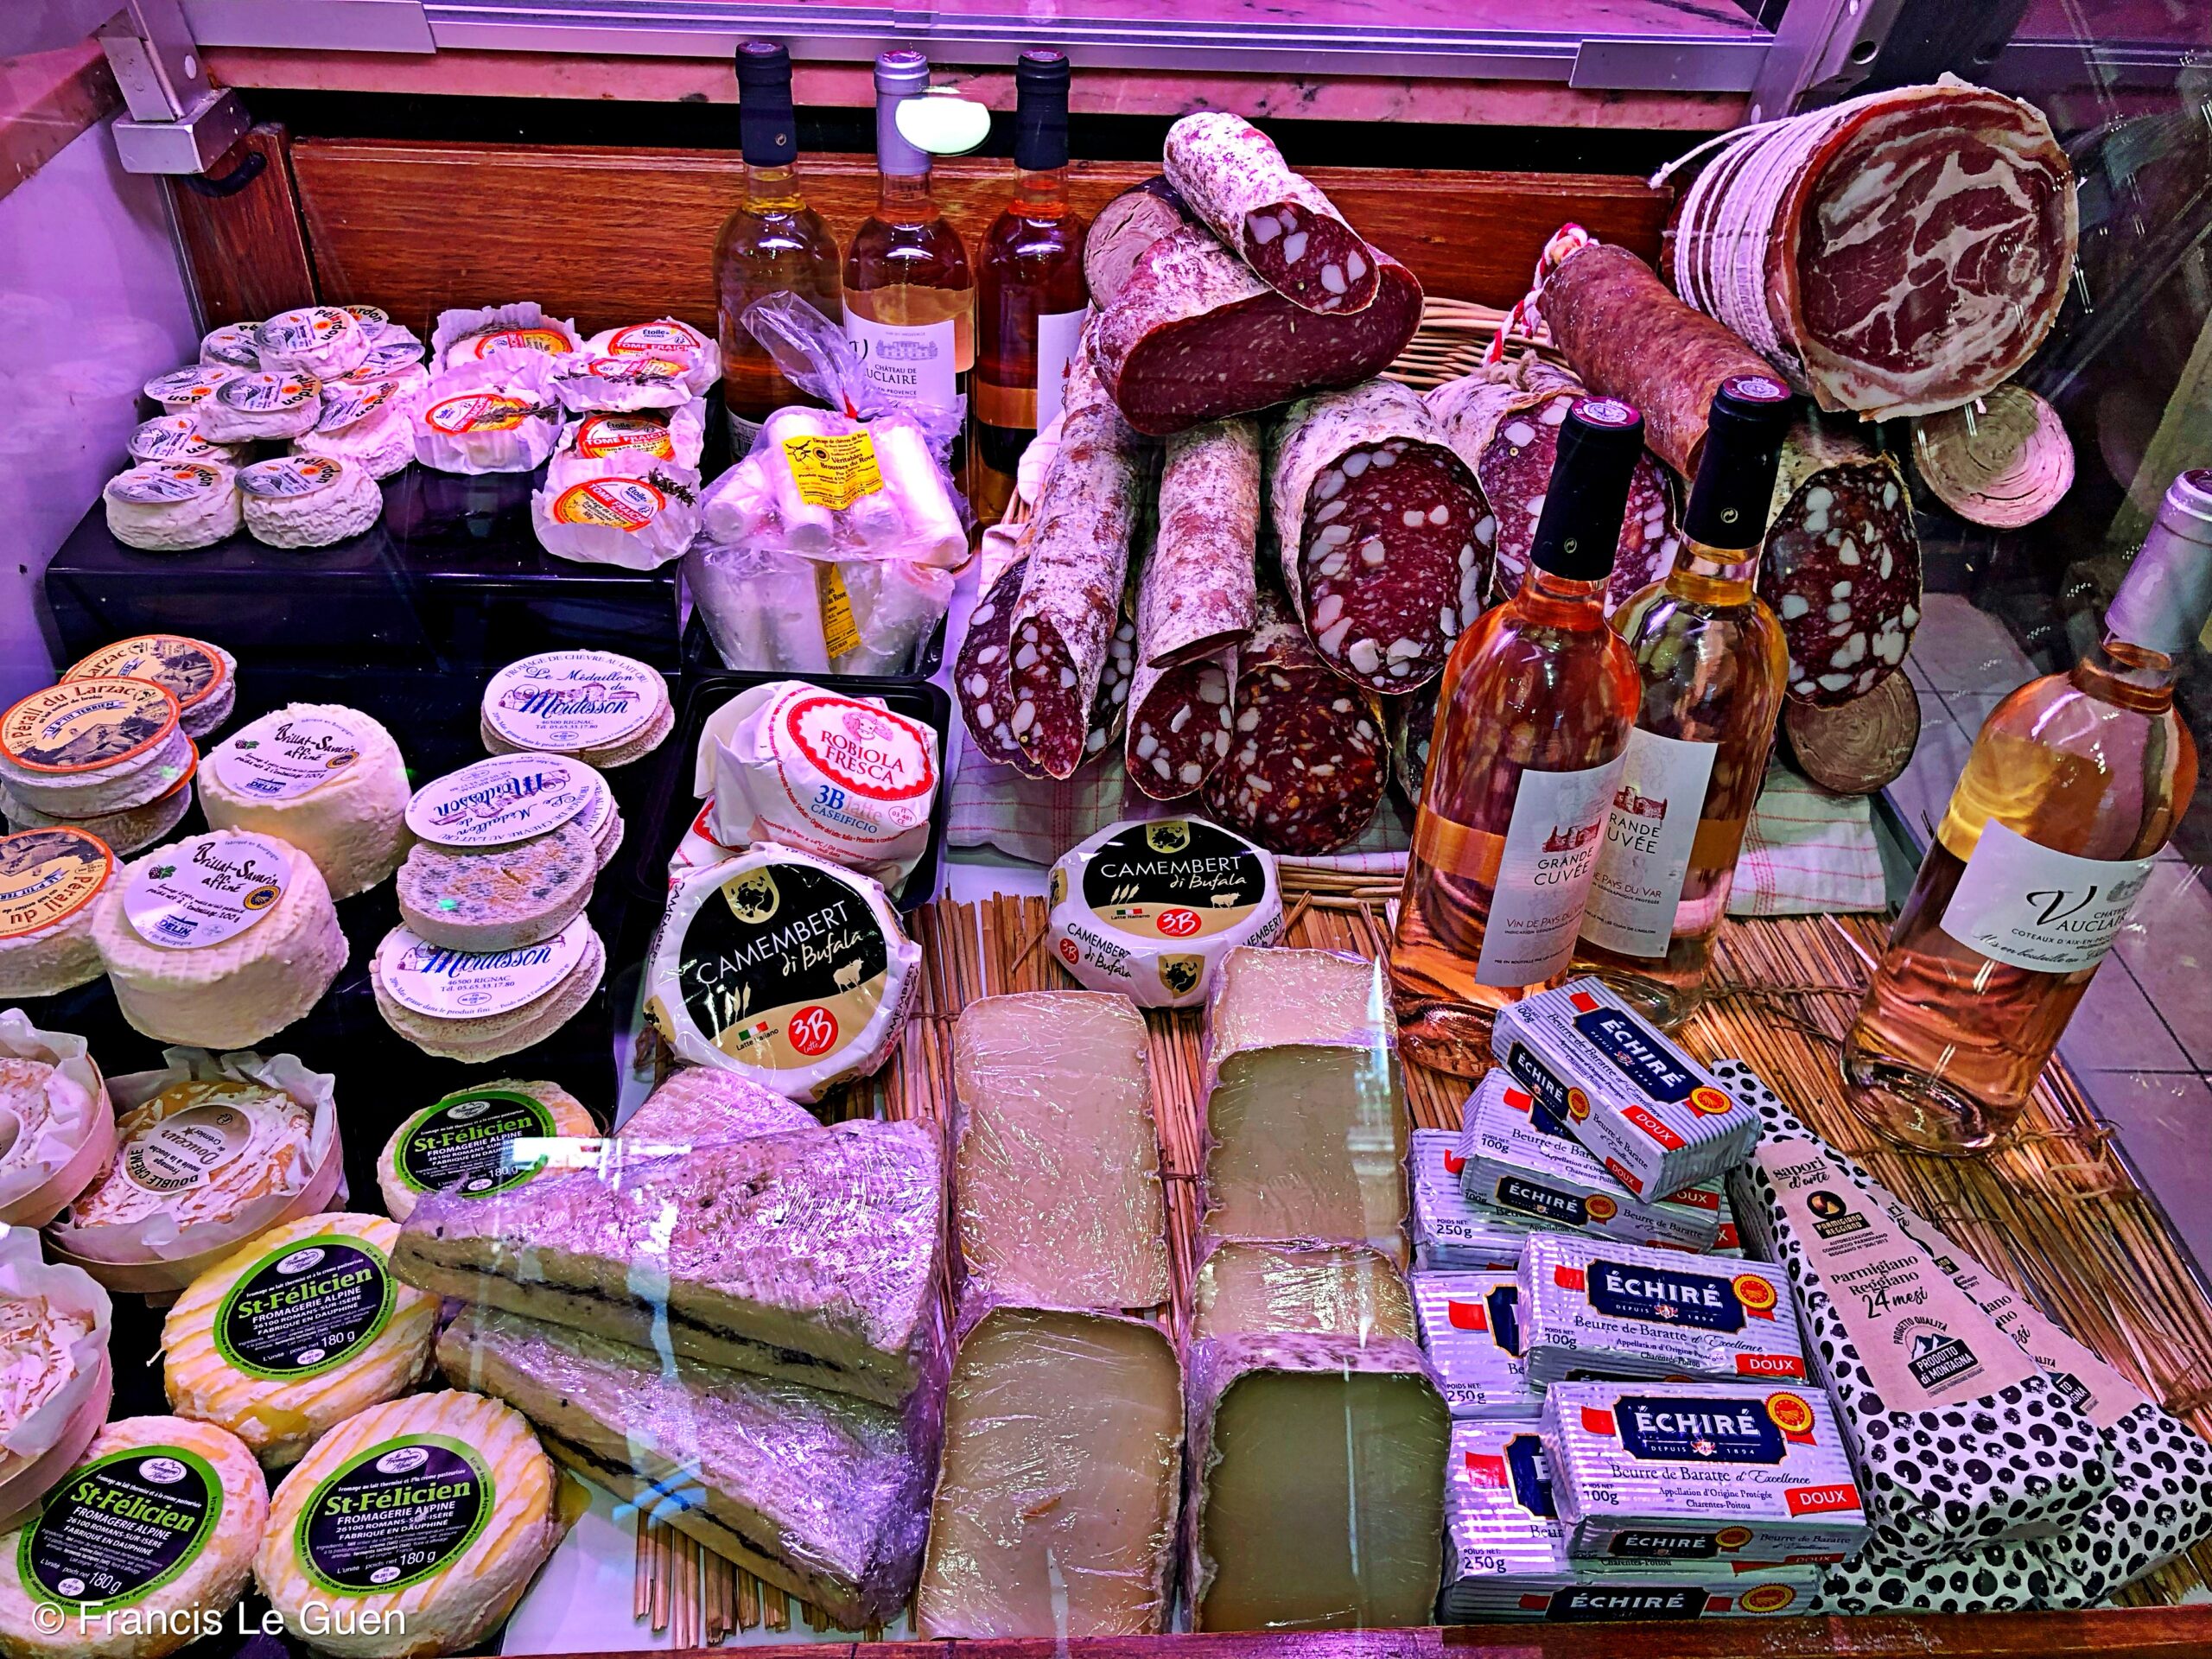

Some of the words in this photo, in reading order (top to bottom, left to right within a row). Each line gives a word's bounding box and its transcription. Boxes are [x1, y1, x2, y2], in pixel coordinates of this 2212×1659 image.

[864, 368, 917, 385] UCLAIRE
[875, 364, 906, 374] CHÂTEAU
[832, 453, 862, 463] Véritables
[858, 454, 875, 464] Rove
[588, 484, 613, 502] TOME
[627, 486, 646, 502] Étoile
[524, 667, 552, 679] Le
[556, 670, 633, 681] Médaillon
[44, 693, 67, 707] du
[74, 686, 136, 696] Larzac
[275, 723, 356, 753] Brillat-Savarin
[284, 747, 326, 761] affiné
[821, 730, 905, 773] ROBIOLA
[825, 747, 895, 785] FRESCA
[251, 781, 282, 792] DELIN
[814, 785, 845, 810] 3B
[810, 803, 878, 835] CASEIFICIO
[1609, 813, 1661, 838] RANDE
[1607, 828, 1656, 855] UVÉE
[194, 842, 278, 886] Brillat-Savarin
[1101, 856, 1241, 878] CAMEMBERT
[1537, 846, 1594, 869] GRANDE
[201, 874, 246, 893] affiné
[1189, 873, 1247, 890] Bufala
[1534, 861, 1590, 887] CUVÉE
[1601, 874, 1623, 890] PAYS
[1624, 884, 1640, 894] DU
[1643, 888, 1662, 899] VAR
[10, 910, 38, 924] du
[159, 919, 192, 937] DELIN
[1162, 911, 1196, 935] 3B
[1506, 918, 1523, 928] VIN
[1526, 918, 1538, 928] DE
[1540, 915, 1559, 928] PAYS
[1561, 912, 1573, 923] DU
[696, 900, 849, 984] CAMEMBERT
[1067, 922, 1132, 959] CAMEMBERT
[2011, 927, 2056, 944] COTEAUX
[802, 928, 863, 971] Bufala
[474, 975, 512, 984] RIGNAC
[791, 1007, 832, 1048] 3B
[1599, 1019, 1687, 1088] ÉCHIRÉ
[1517, 1052, 1563, 1103] ÉCHIRÉ
[414, 1116, 533, 1153] St-Félicien
[1635, 1113, 1675, 1141] DOUX
[160, 1129, 219, 1165] Douceur
[427, 1138, 488, 1156] FROMAGERIE
[490, 1130, 524, 1142] ALPINE
[1481, 1137, 1510, 1154] 100g
[1593, 1113, 1616, 1139] Beurre
[1624, 1141, 1649, 1169] Baratte
[129, 1149, 151, 1179] CRÈME
[153, 1158, 181, 1175] Fromage
[1611, 1165, 1635, 1185] DOUX
[1773, 1156, 1827, 1180] sapori
[146, 1174, 198, 1188] DOUBLE
[1509, 1183, 1578, 1213] ÉCHIRÉ
[1624, 1209, 1655, 1226] Beurre
[1656, 1220, 1667, 1230] de
[1669, 1221, 1703, 1238] Baratte
[1816, 1214, 1863, 1230] PARMIGIANO
[1825, 1222, 1862, 1236] REGGIANO
[1830, 1255, 1918, 1284] Parmigiano
[238, 1268, 373, 1320] St-Félicien
[1606, 1270, 1723, 1308] ÉCHIRÉ
[1848, 1271, 1919, 1296] Reggiano
[252, 1298, 323, 1324] FROMAGERIE
[323, 1286, 361, 1304] ALPINE
[252, 1319, 280, 1331] 26100
[281, 1294, 362, 1324] ROMANS-SUR-ISÈRE
[1862, 1287, 1891, 1319] 24
[1892, 1286, 1928, 1306] mesi
[257, 1319, 301, 1336] FABRIQUÉ
[302, 1315, 315, 1324] EN
[315, 1302, 359, 1321] DAUPHINÉ
[1575, 1315, 1618, 1332] Beurre
[1623, 1323, 1637, 1333] de
[1640, 1324, 1688, 1341] Baratte
[1893, 1317, 1915, 1344] PROGETTO
[1915, 1316, 1948, 1332] QUALITÀ
[321, 1332, 345, 1348] 180
[346, 1331, 355, 1343] g
[1545, 1333, 1577, 1350] 100g
[1750, 1358, 1795, 1370] DOUX
[1916, 1345, 1958, 1371] PRODOTTO
[1920, 1372, 1930, 1384] di
[1929, 1352, 1974, 1379] MONTAGNA
[1634, 1405, 1761, 1437] ÉCHIRÉ
[1611, 1464, 1658, 1479] Beurre
[1662, 1467, 1677, 1480] de
[1681, 1466, 1731, 1482] Baratte
[324, 1481, 471, 1517] St-Félicien
[1659, 1487, 1701, 1497] Appellation
[1703, 1487, 1738, 1499] d'Origine
[1740, 1490, 1772, 1499] Protégée
[1686, 1499, 1751, 1510] Charentes-Poitou
[1799, 1491, 1847, 1505] DOUX
[70, 1482, 195, 1534] St-Félicien
[337, 1507, 412, 1525] FROMAGERIE
[67, 1516, 90, 1529] 26100
[89, 1522, 163, 1549] ROMANS-SUR-ISÈRE
[73, 1506, 136, 1532] FROMAGERIE
[135, 1523, 172, 1541] ALPINE
[335, 1523, 365, 1534] 26100
[339, 1529, 386, 1541] FABRIQUÉ
[401, 1519, 449, 1533] DAUPHINÉ
[63, 1525, 102, 1542] FABRIQUÉ
[102, 1537, 113, 1547] EN
[112, 1540, 154, 1556] DAUPHINÉ
[1624, 1535, 1707, 1548] ÉCHIRÉ
[399, 1551, 425, 1566] 180
[426, 1550, 436, 1563] g
[88, 1570, 114, 1589] 180
[111, 1580, 123, 1593] g
[1569, 1592, 1684, 1609] ÉCHIRÉ
